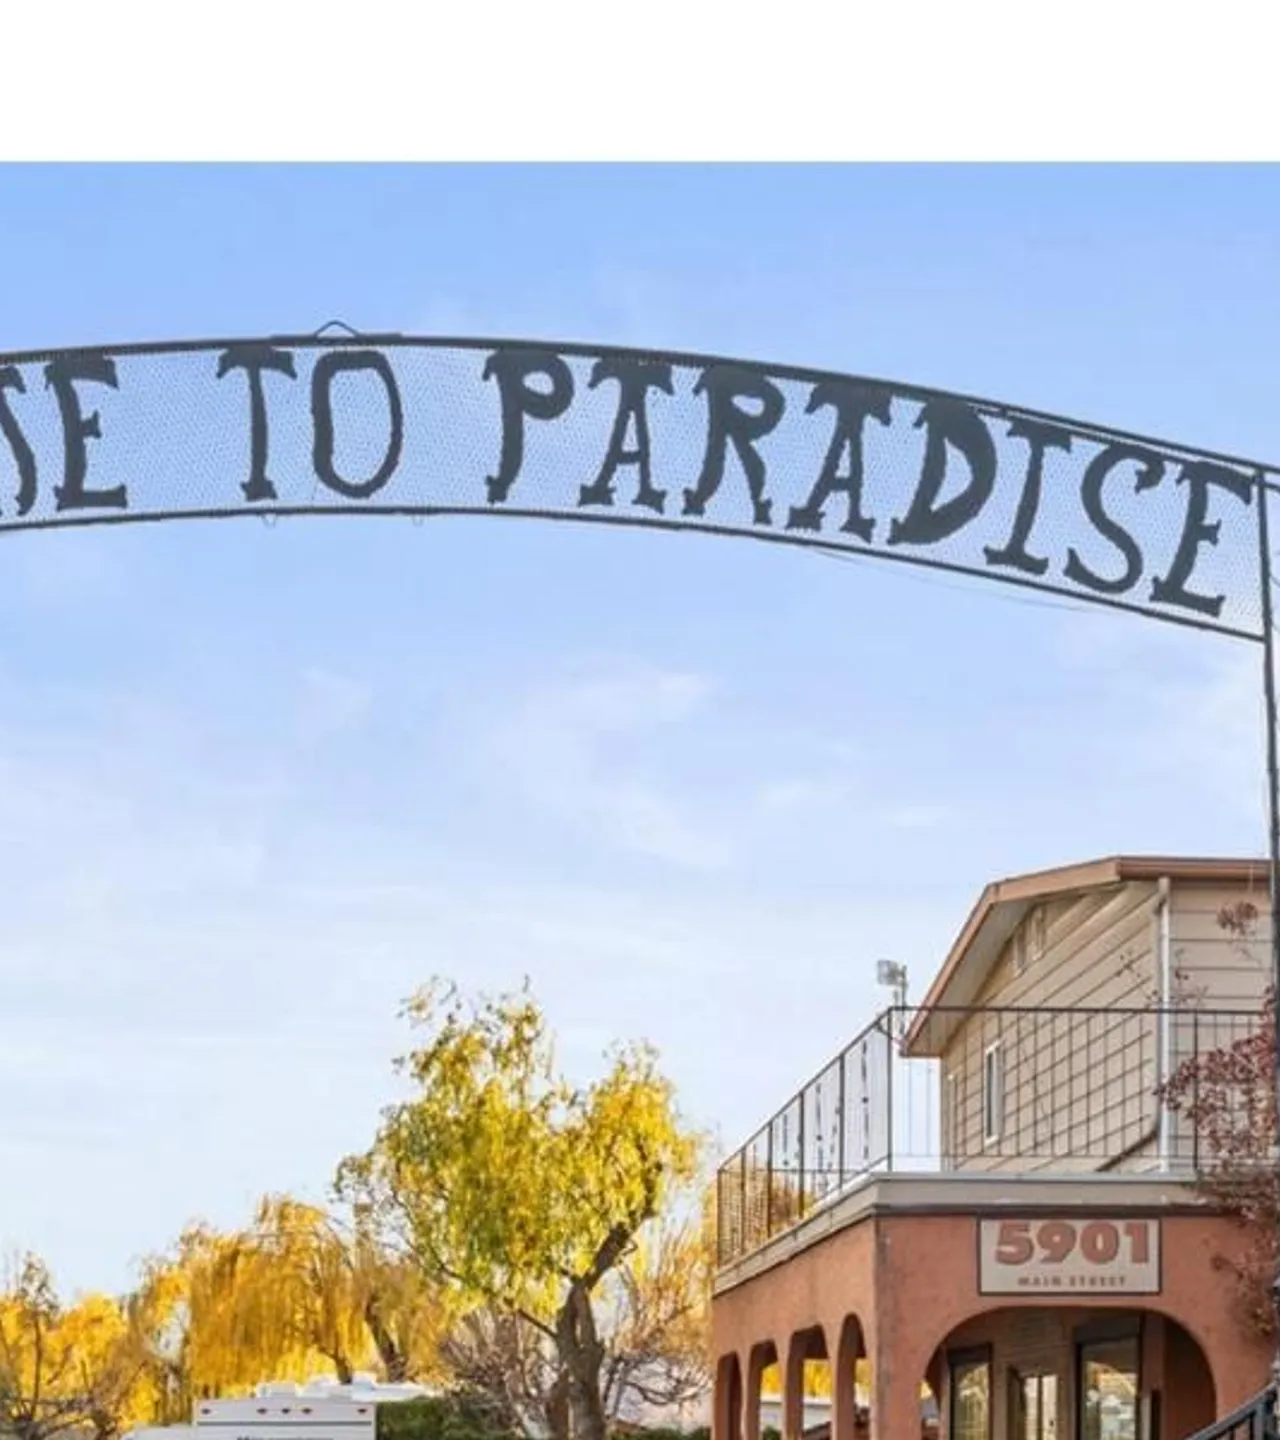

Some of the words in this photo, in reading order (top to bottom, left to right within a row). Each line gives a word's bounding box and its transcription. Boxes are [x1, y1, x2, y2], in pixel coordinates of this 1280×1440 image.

[217, 346, 403, 501] TO
[482, 342, 1257, 617] PARADISE
[996, 1221, 1150, 1266] 5901
[1017, 1276, 1062, 1287] MAIN
[1069, 1276, 1126, 1287] STREET
